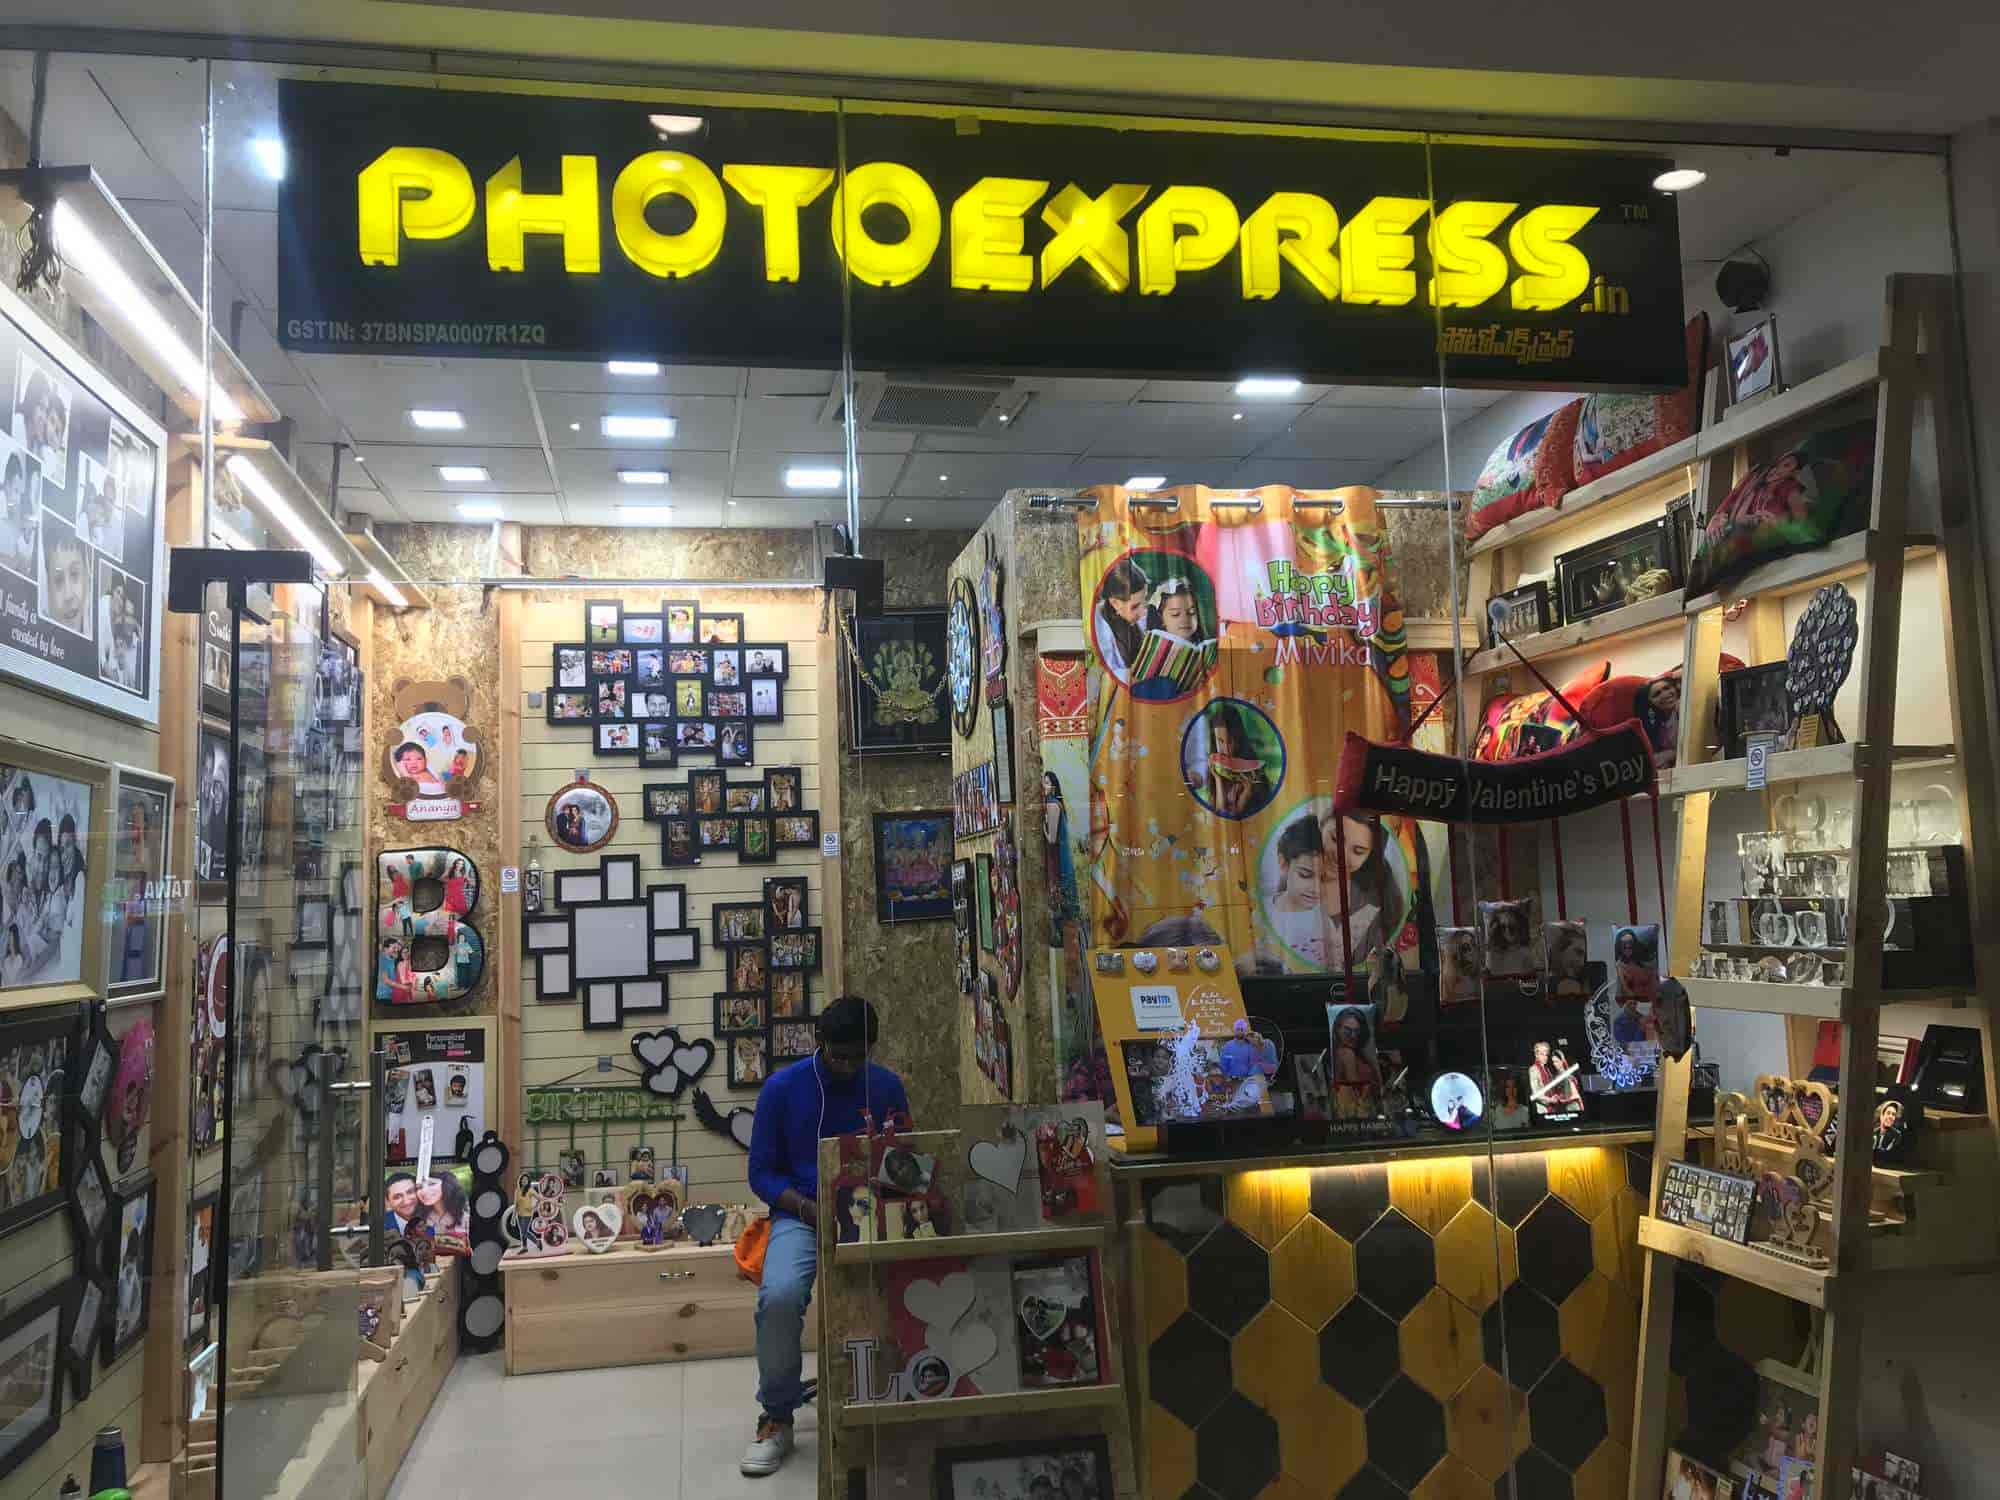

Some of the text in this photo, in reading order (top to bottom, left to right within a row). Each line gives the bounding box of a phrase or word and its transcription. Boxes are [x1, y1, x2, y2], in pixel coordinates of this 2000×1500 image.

[358, 146, 1600, 311] PHOTOEXPRESS
[287, 319, 355, 341] GSTIN:
[1254, 591, 1379, 638] Birhday
[1275, 636, 1373, 668] Mlvika
[1374, 763, 1457, 809] Happy
[1600, 753, 1646, 786] Day
